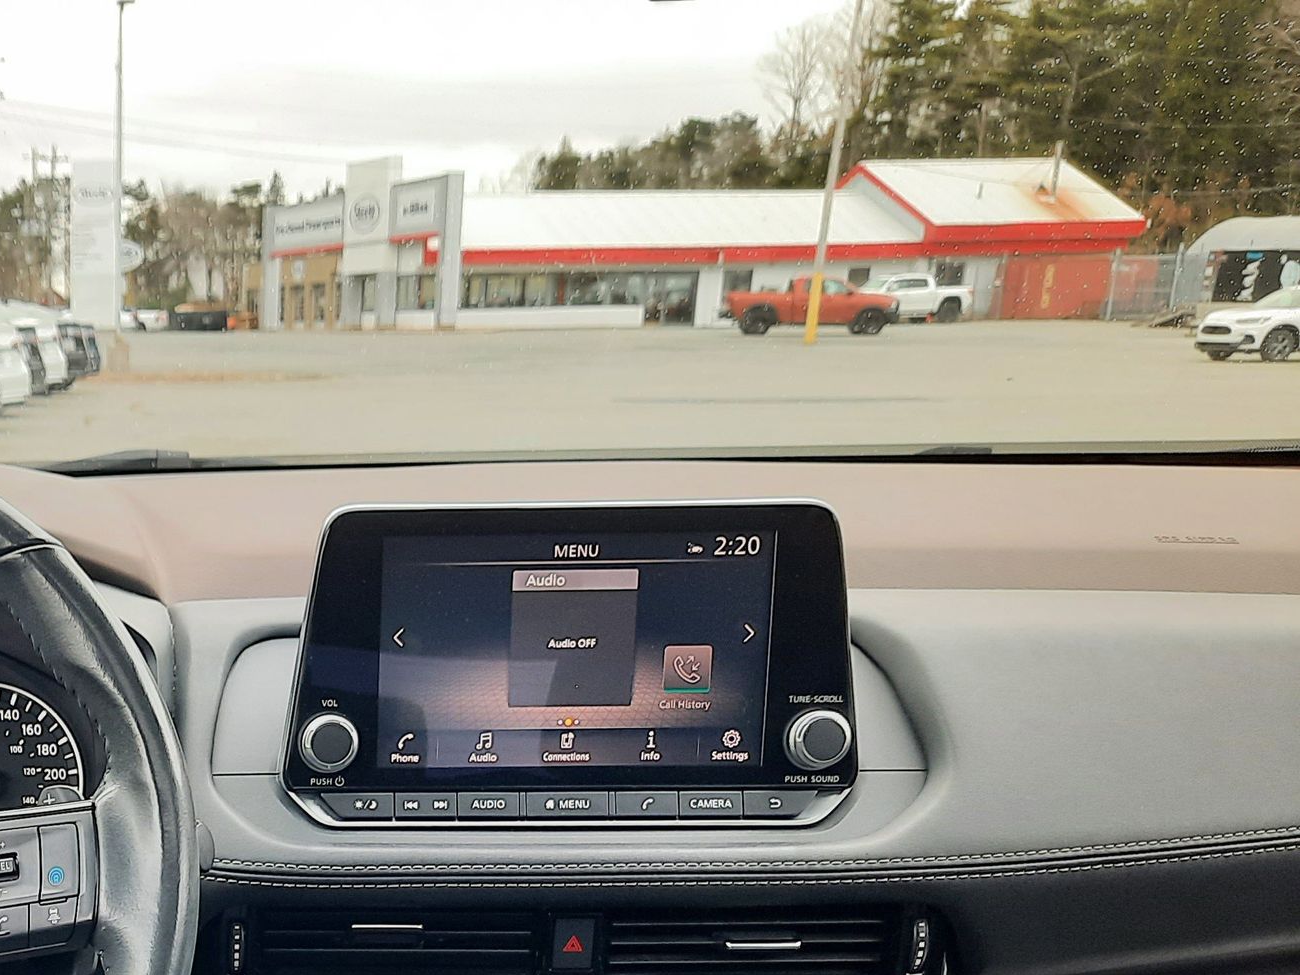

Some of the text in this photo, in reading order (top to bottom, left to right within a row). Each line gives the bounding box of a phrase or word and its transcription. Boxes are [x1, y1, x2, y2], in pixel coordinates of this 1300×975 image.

[713, 535, 761, 556] 2:20
[553, 544, 600, 559] MENU
[525, 573, 567, 588] Audio
[547, 637, 597, 649] Audio OFF
[321, 697, 339, 708] VOL
[659, 699, 711, 712] Call History
[0, 709, 20, 722] 140
[21, 723, 42, 736] 160
[9, 744, 23, 754] 100
[36, 743, 58, 756] 180
[390, 752, 420, 764] Phone
[469, 752, 498, 763] Audio
[542, 751, 591, 762] Connections
[640, 751, 661, 761] Info
[711, 751, 749, 762] Settings
[23, 767, 36, 776] 120
[44, 768, 67, 781] 200
[310, 777, 333, 787] PUSH
[784, 775, 840, 784] PUSH SOUND
[471, 799, 506, 809] AUDIO
[559, 799, 590, 810] MENU
[690, 799, 732, 809] CAMERA
